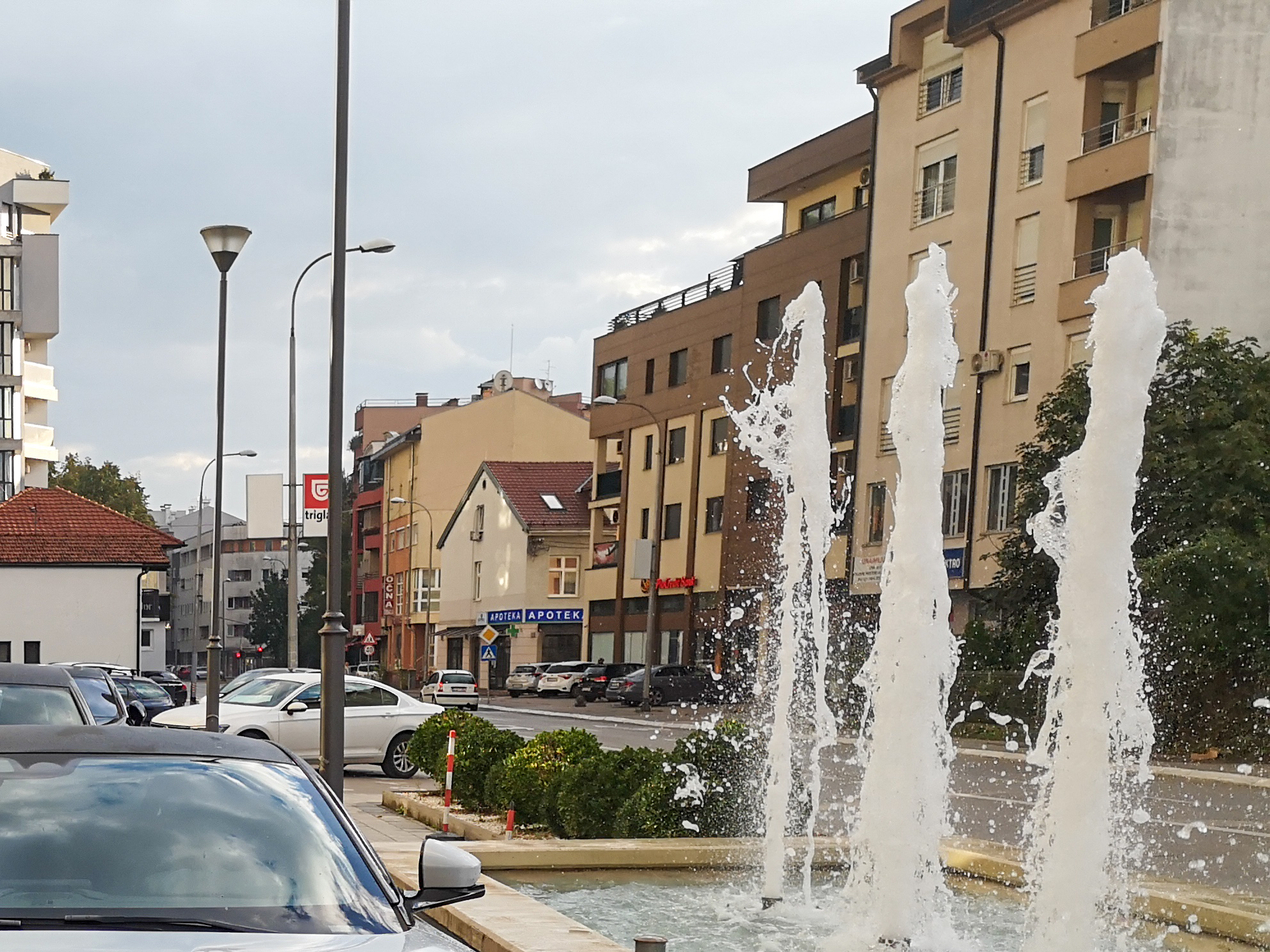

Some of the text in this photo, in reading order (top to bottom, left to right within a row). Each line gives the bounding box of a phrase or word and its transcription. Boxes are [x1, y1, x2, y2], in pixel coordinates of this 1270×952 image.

[385, 575, 394, 609] OČNA
[490, 611, 521, 622] APOTEKA
[528, 610, 584, 620] APOTEK
